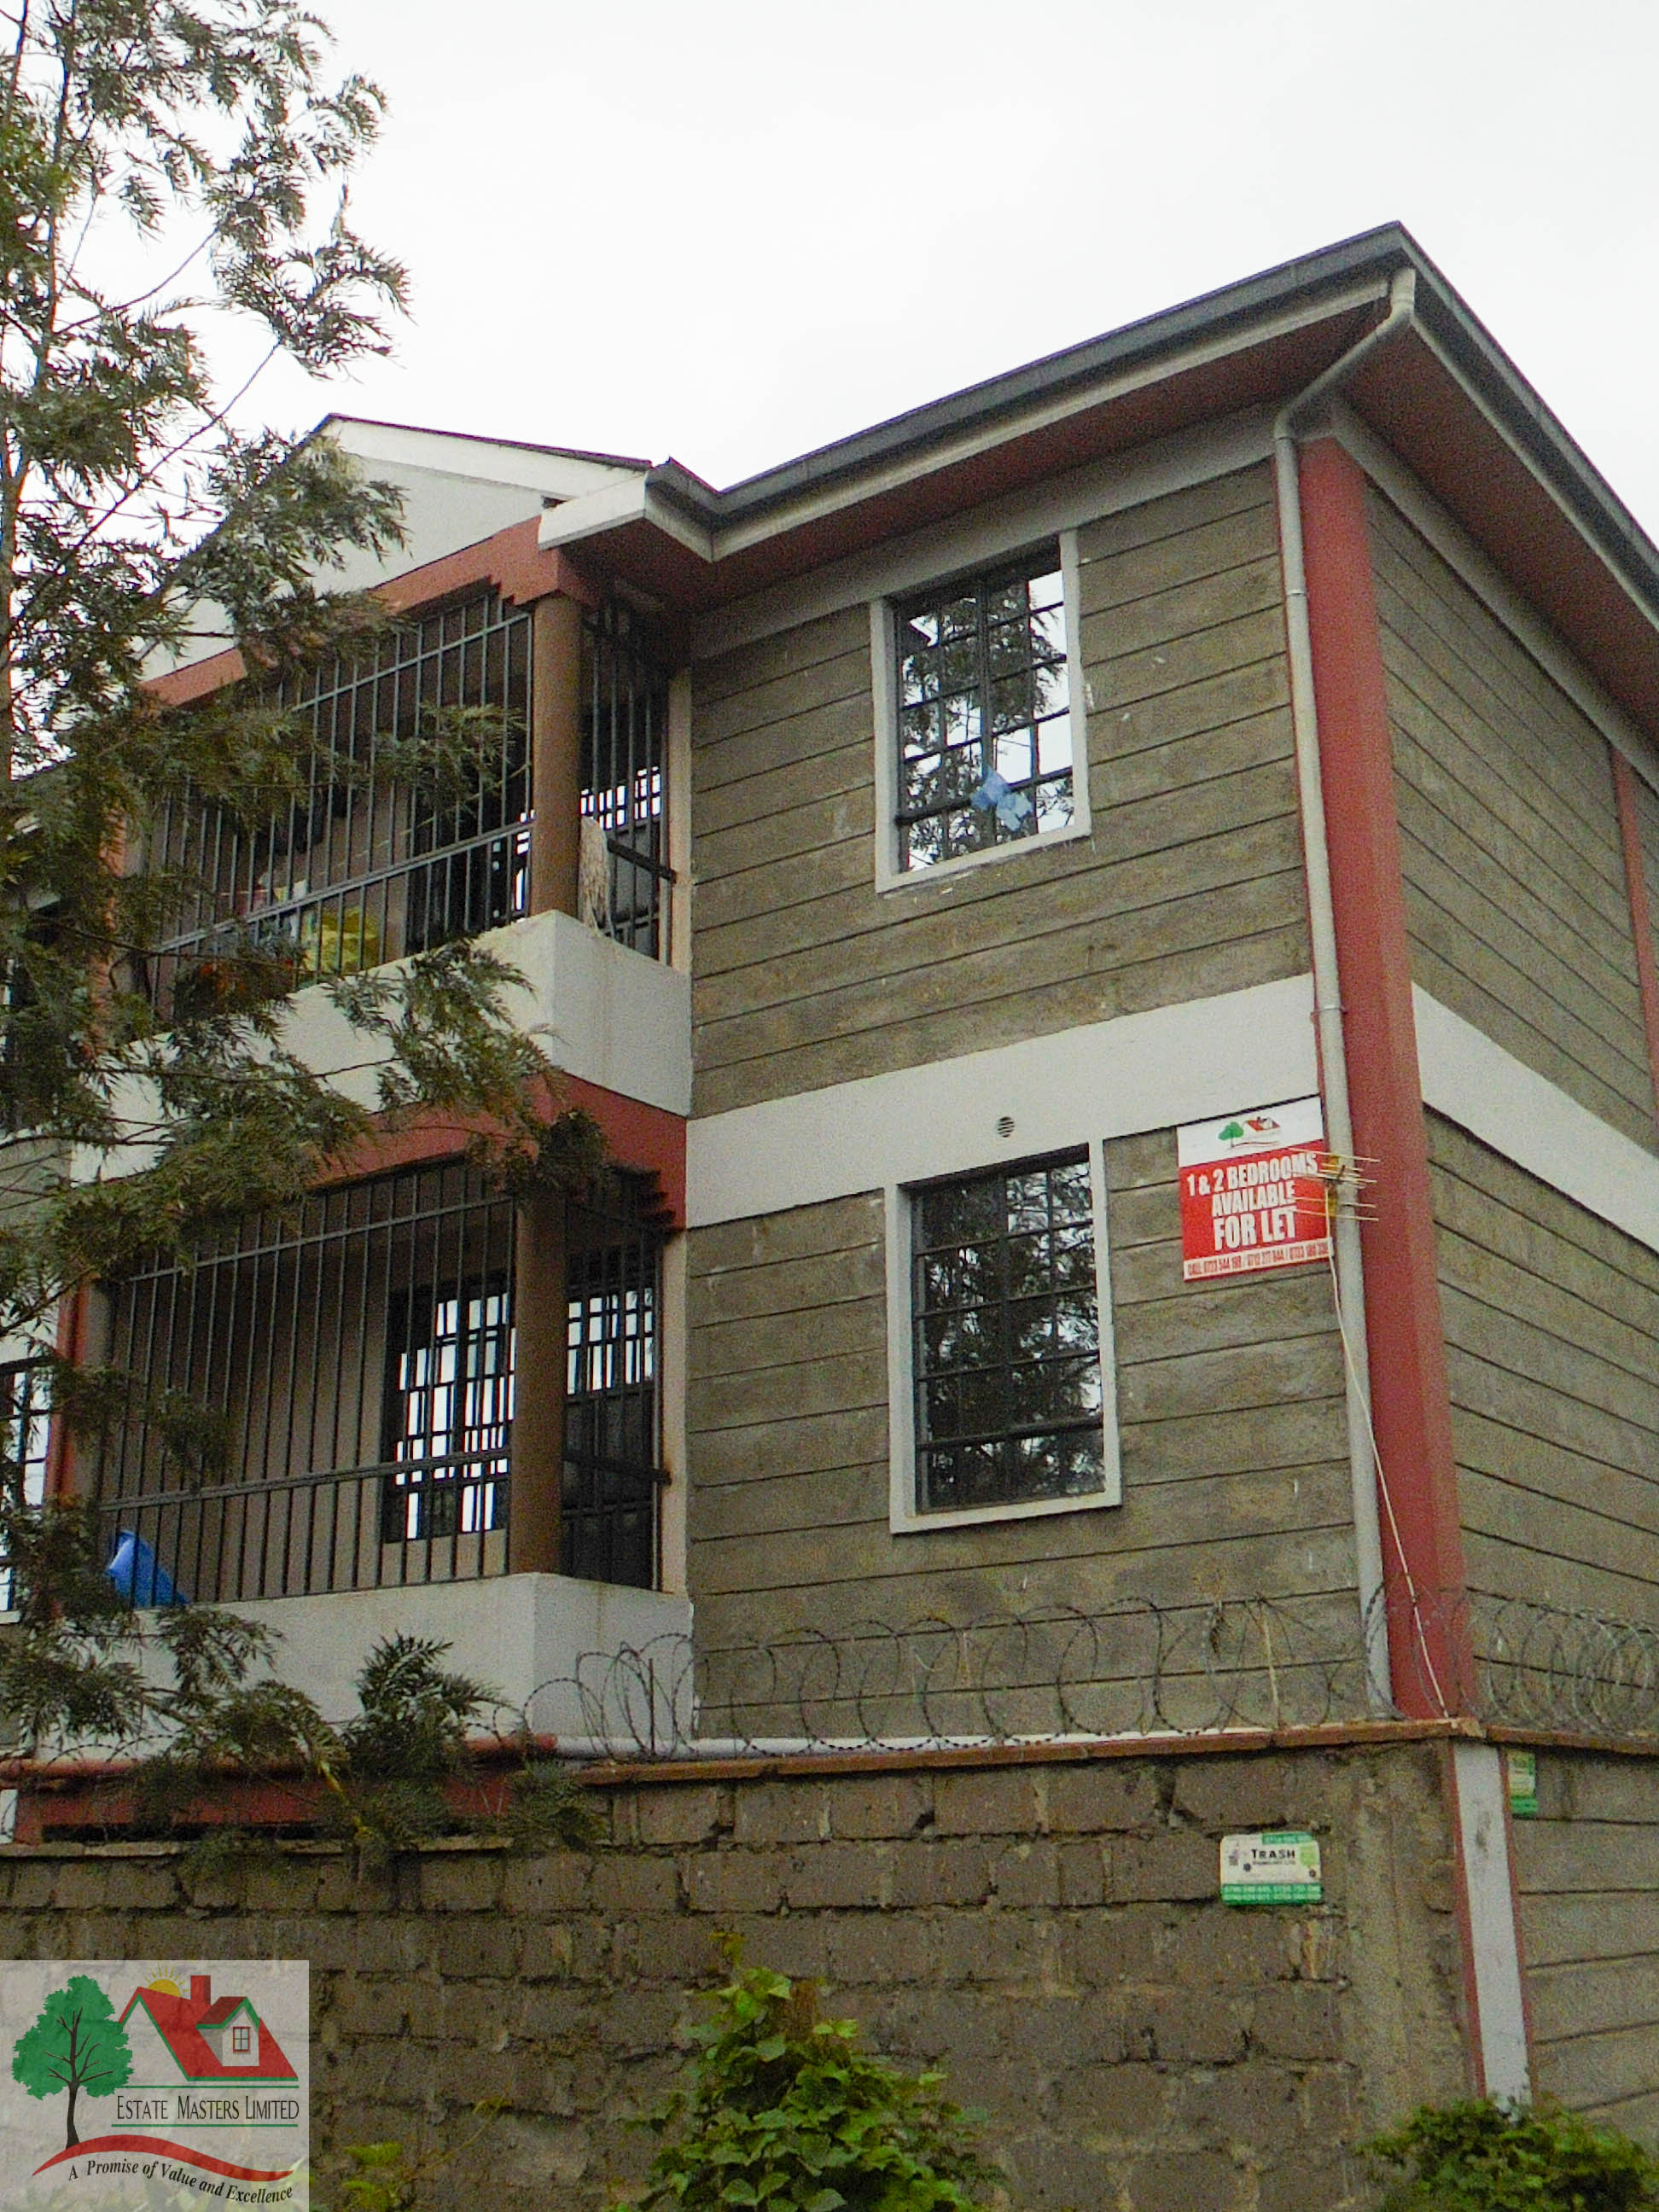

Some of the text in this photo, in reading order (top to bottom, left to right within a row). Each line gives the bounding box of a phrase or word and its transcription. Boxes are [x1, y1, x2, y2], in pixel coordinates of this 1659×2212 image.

[1187, 1153, 1318, 1196] 1 & 2 BEDROOMS
[1213, 1181, 1295, 1218] AVAILABLE
[1214, 1206, 1297, 1251] FOR LET
[1251, 1848, 1295, 1860] TRASH
